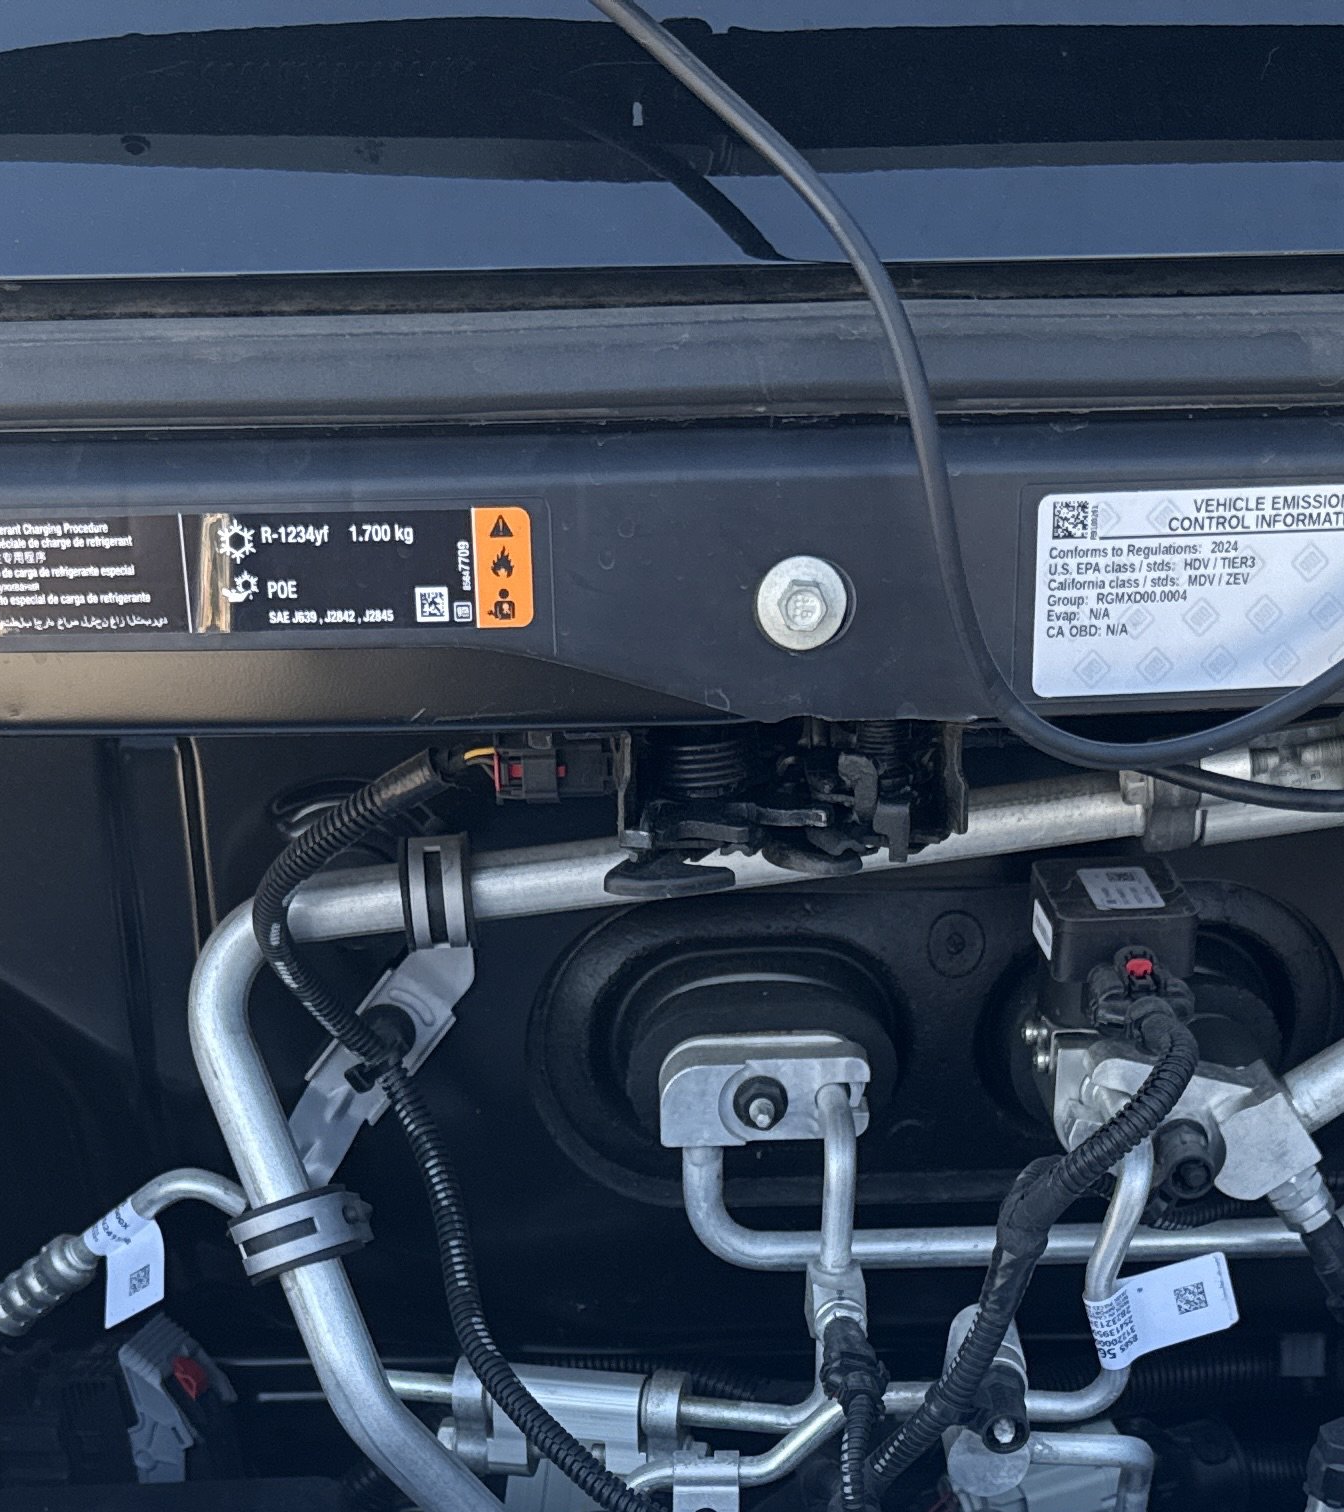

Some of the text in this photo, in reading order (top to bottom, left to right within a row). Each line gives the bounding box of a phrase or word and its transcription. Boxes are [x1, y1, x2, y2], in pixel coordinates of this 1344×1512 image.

[1194, 496, 1265, 513] VEHICLE
[23, 522, 62, 536] Charging
[63, 522, 108, 535] Procedure
[1168, 515, 1250, 532] CONTROL
[261, 524, 414, 545] R-1234yf 1.700 kg
[28, 538, 39, 548] de
[41, 537, 71, 550] charge
[73, 537, 84, 547] de
[1049, 541, 1238, 560] Conforms to Regulations: 2024
[2, 568, 13, 578] de
[14, 567, 37, 579] carga
[39, 567, 50, 578] de
[51, 565, 99, 579] refrigerante
[101, 564, 135, 577] especial
[1049, 564, 1073, 576] U.S.
[1077, 562, 1101, 574] EPA
[1105, 561, 1136, 573] class
[1146, 560, 1176, 572] stds:
[1184, 558, 1210, 571] HDV
[1220, 556, 1256, 569] TIER3
[267, 580, 297, 599] POE
[1048, 578, 1105, 591] California
[1108, 576, 1139, 589] class
[1151, 575, 1179, 587] stds:
[1188, 574, 1215, 587] MDV
[1225, 573, 1250, 585] ZEV
[10, 594, 46, 607] especial
[48, 594, 59, 605] de
[60, 594, 86, 606] carga
[87, 593, 98, 604] de
[100, 592, 151, 606] refrigerante
[1048, 594, 1088, 609] Group:
[269, 610, 290, 623] SAE
[1047, 608, 1110, 624] Evap: N/A
[1046, 624, 1128, 638] CA OBD: N/A
